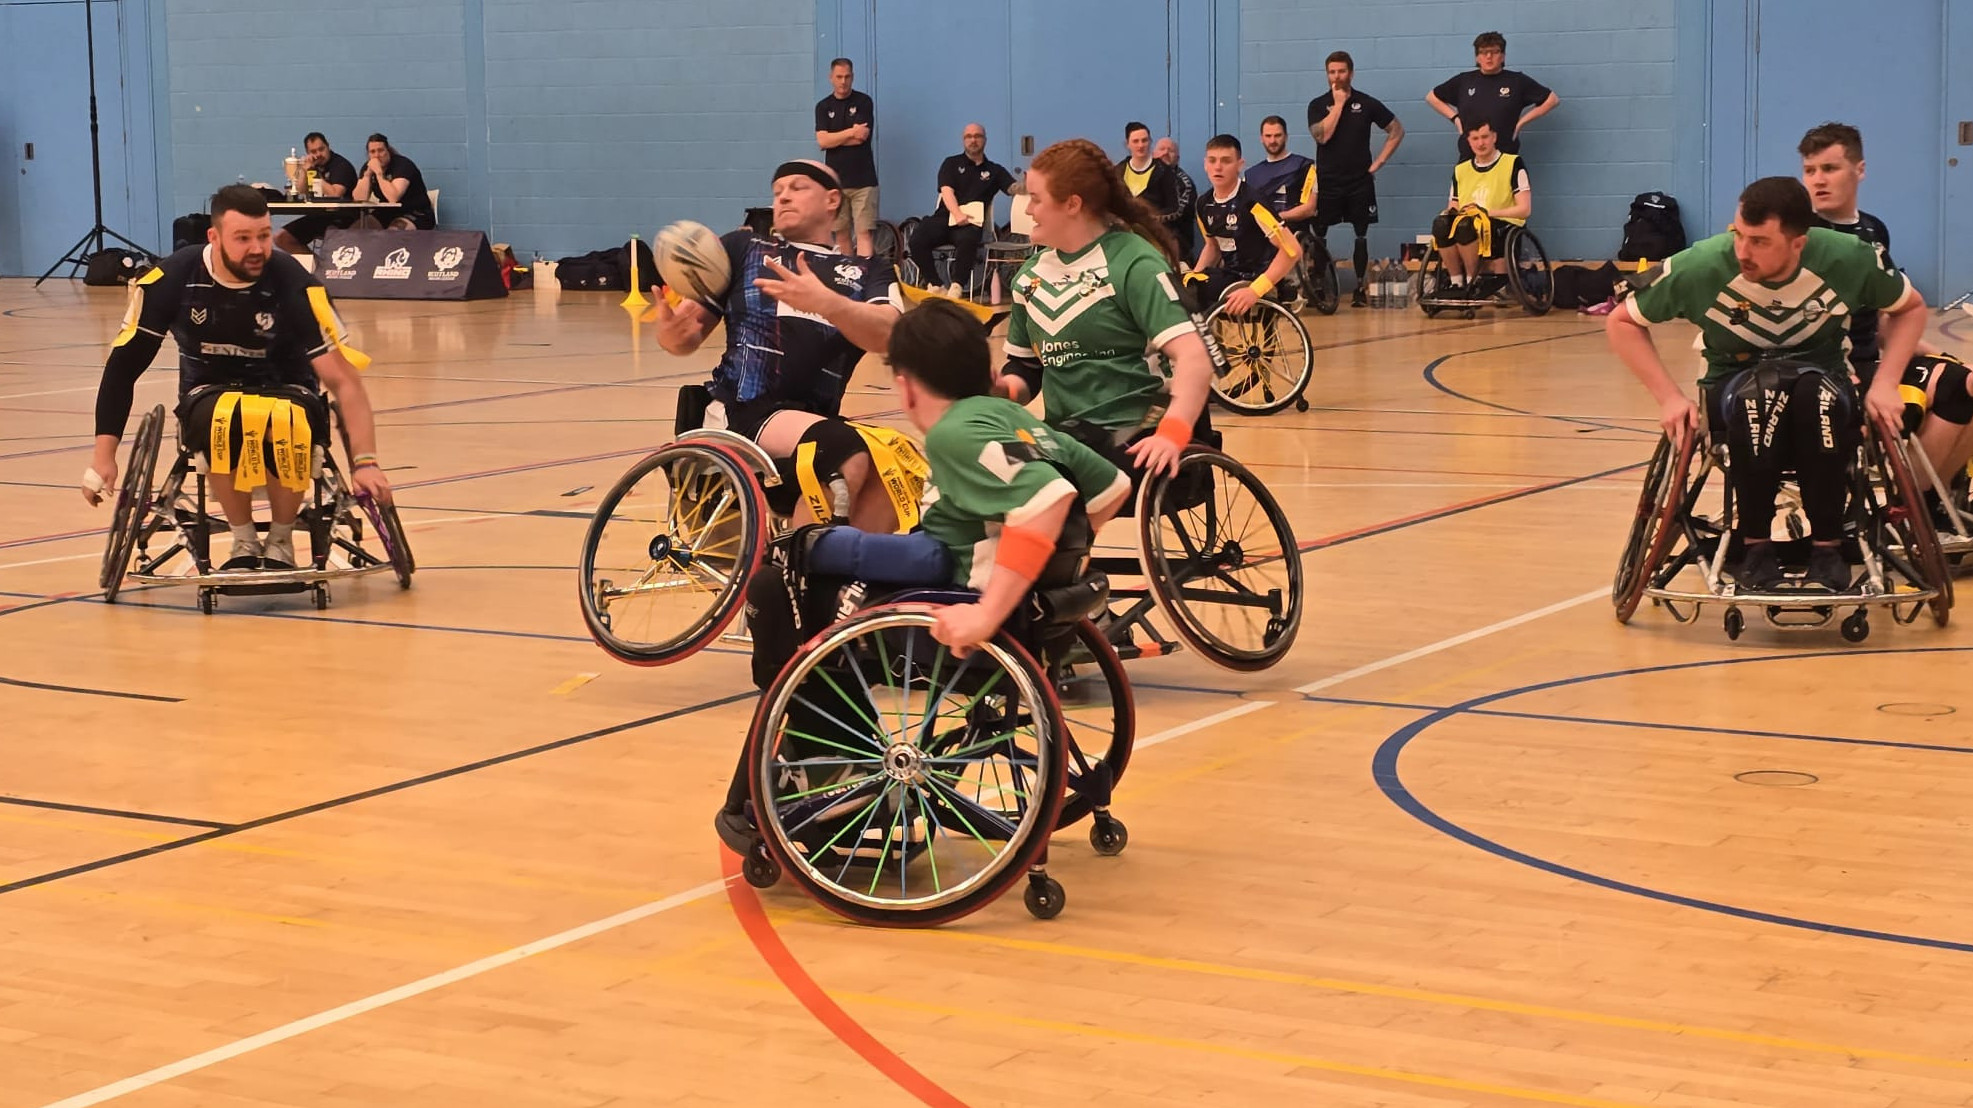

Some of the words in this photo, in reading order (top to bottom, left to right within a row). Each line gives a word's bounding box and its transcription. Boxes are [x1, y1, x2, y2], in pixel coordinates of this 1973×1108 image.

[1041, 340, 1080, 354] Jones
[1763, 390, 1789, 448] ZILAND
[1819, 389, 1834, 448] ZILAND
[890, 477, 906, 505] WORLD
[902, 503, 911, 518] CUP
